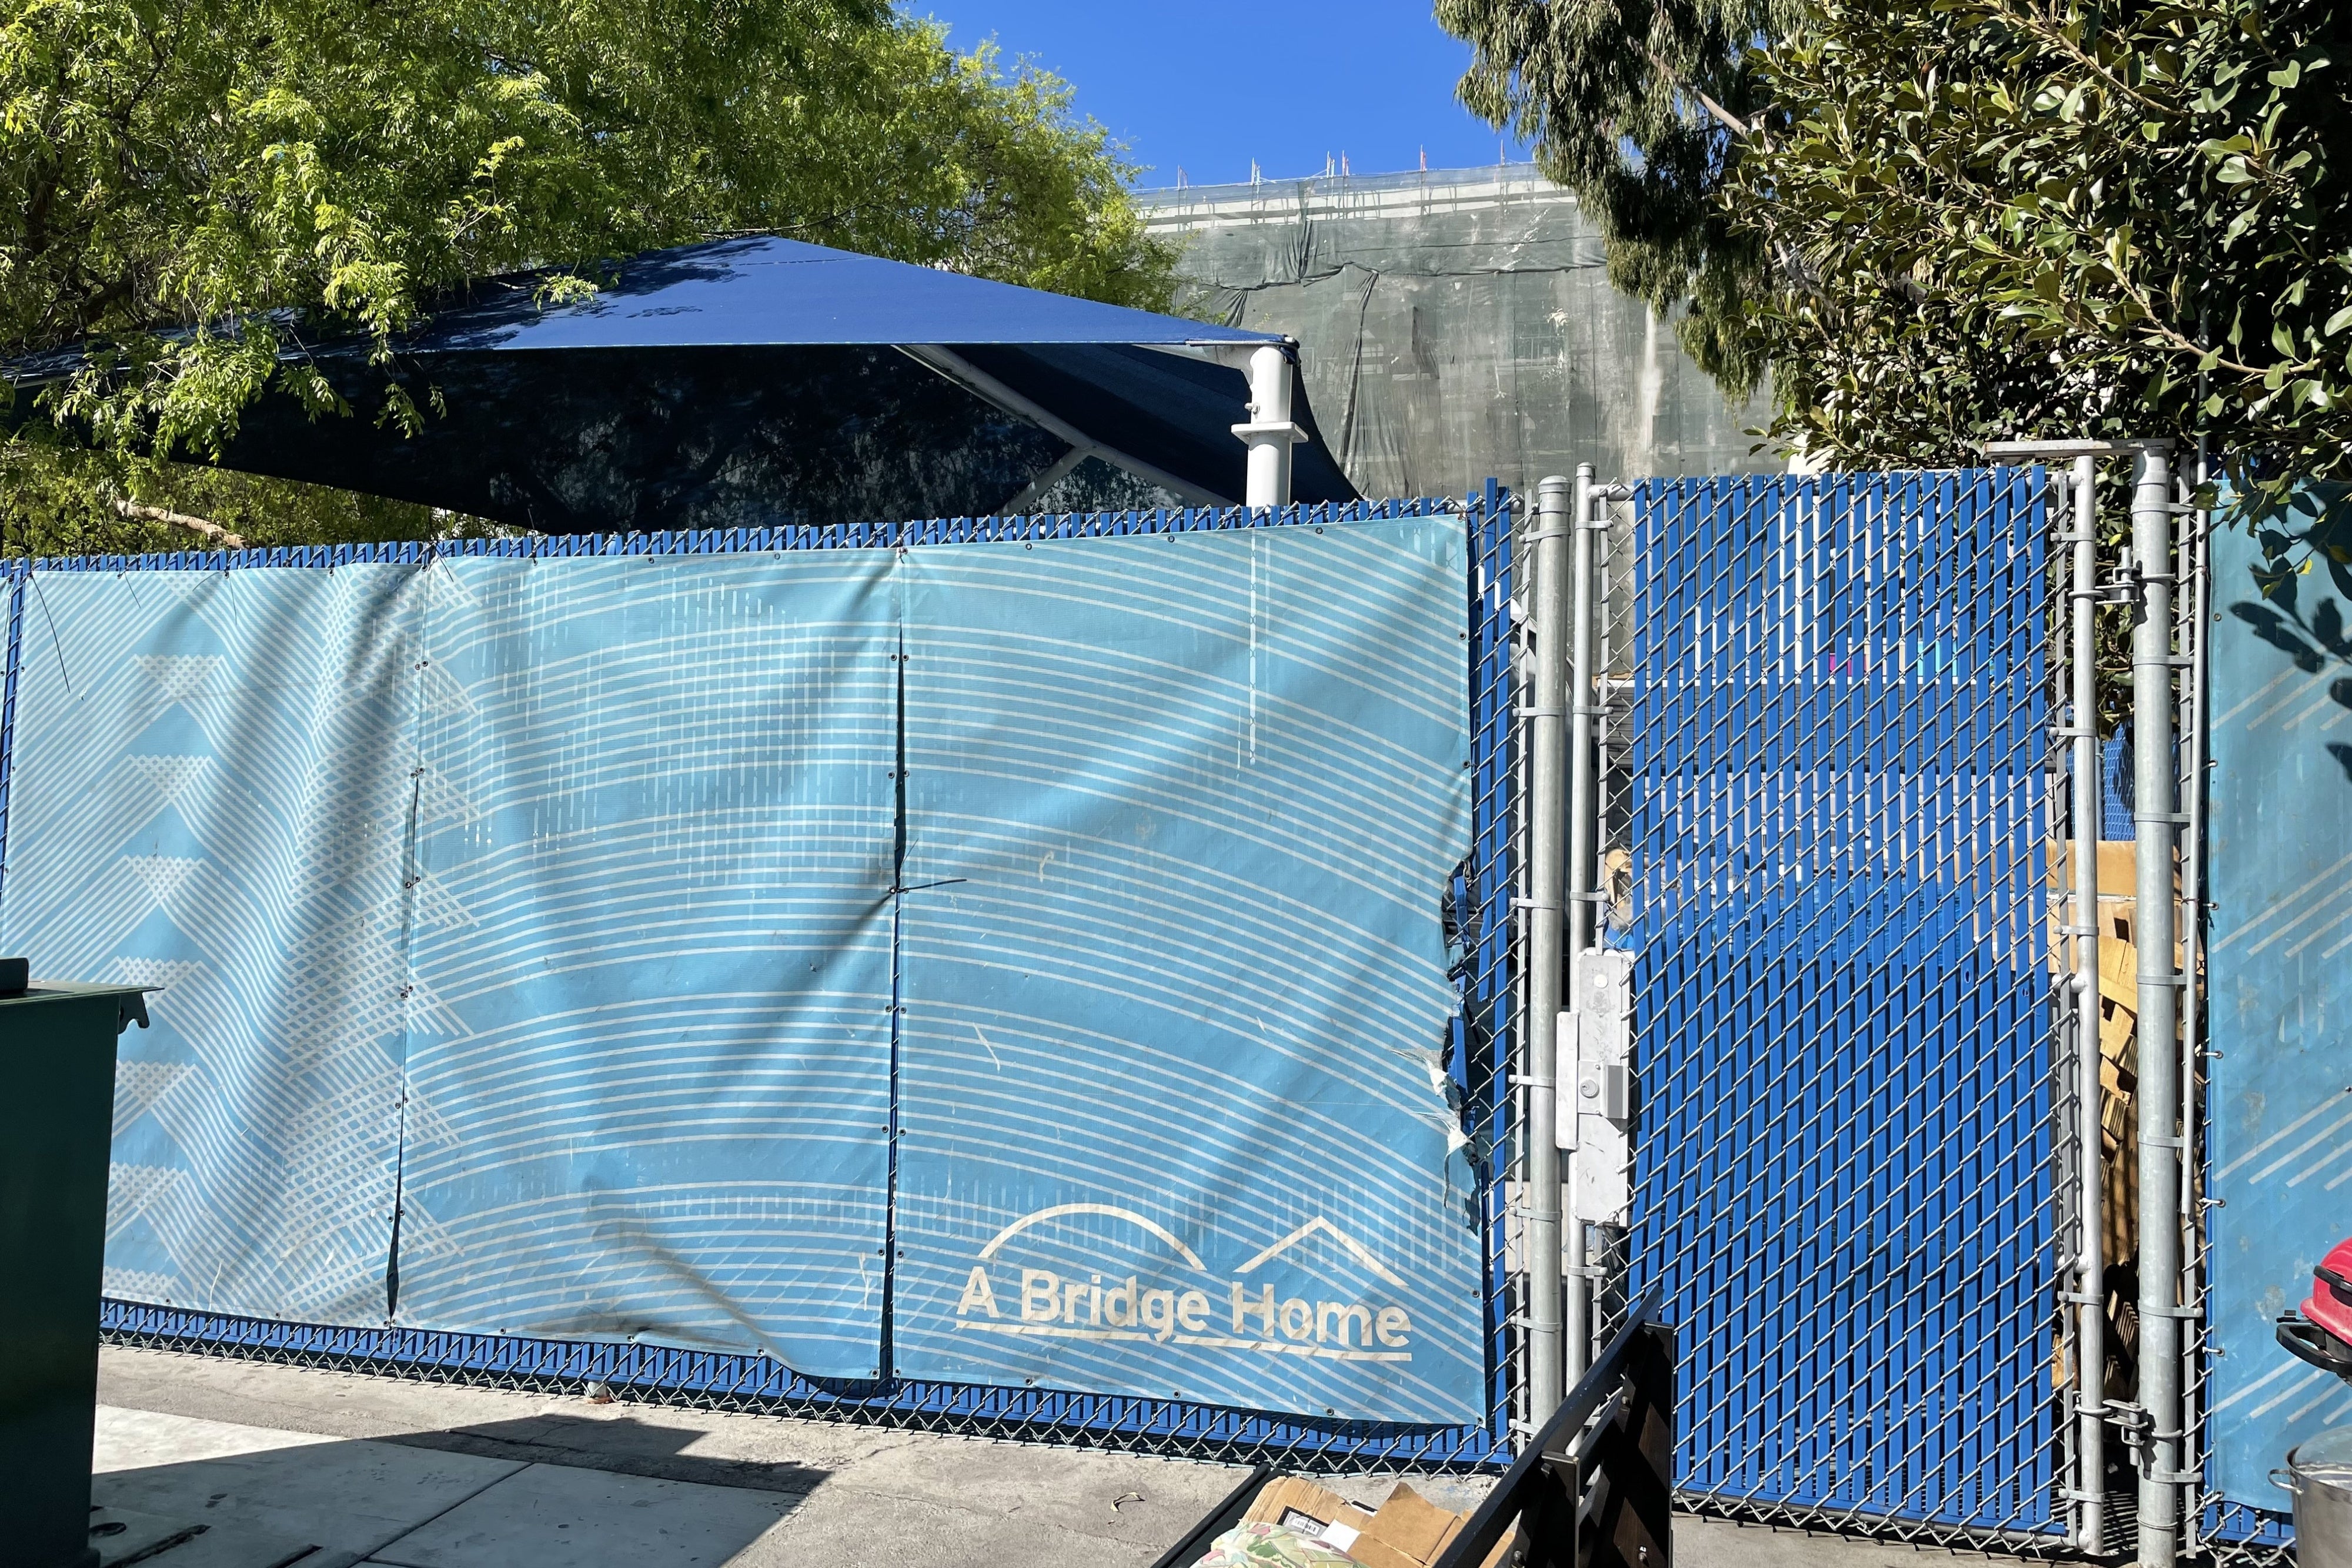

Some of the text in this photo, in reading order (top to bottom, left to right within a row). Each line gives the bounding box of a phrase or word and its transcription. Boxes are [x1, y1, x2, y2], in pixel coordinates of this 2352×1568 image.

[956, 1266, 1412, 1347] A Bridge Home
